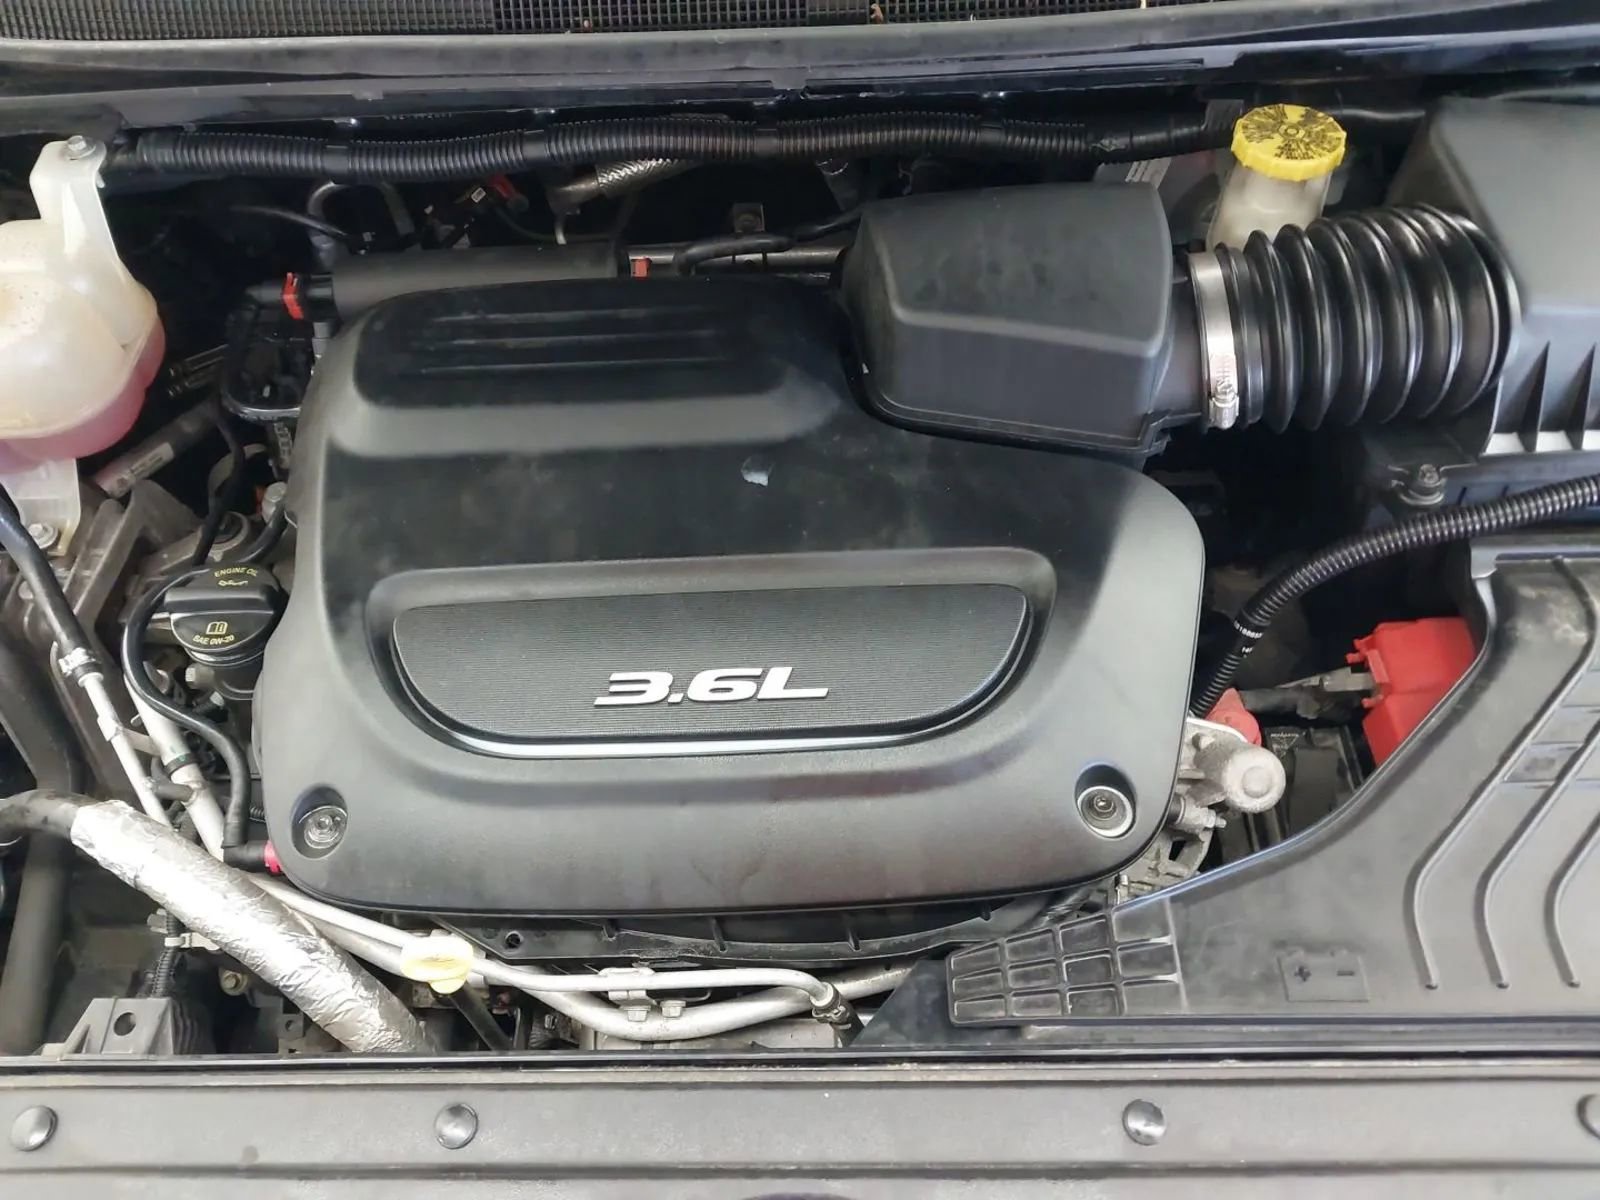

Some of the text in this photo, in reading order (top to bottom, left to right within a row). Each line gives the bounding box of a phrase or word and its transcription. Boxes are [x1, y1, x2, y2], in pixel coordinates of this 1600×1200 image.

[214, 567, 258, 577] ENGINE OIL
[193, 635, 234, 645] SAE 0W-20
[594, 667, 829, 706] 3.6L
